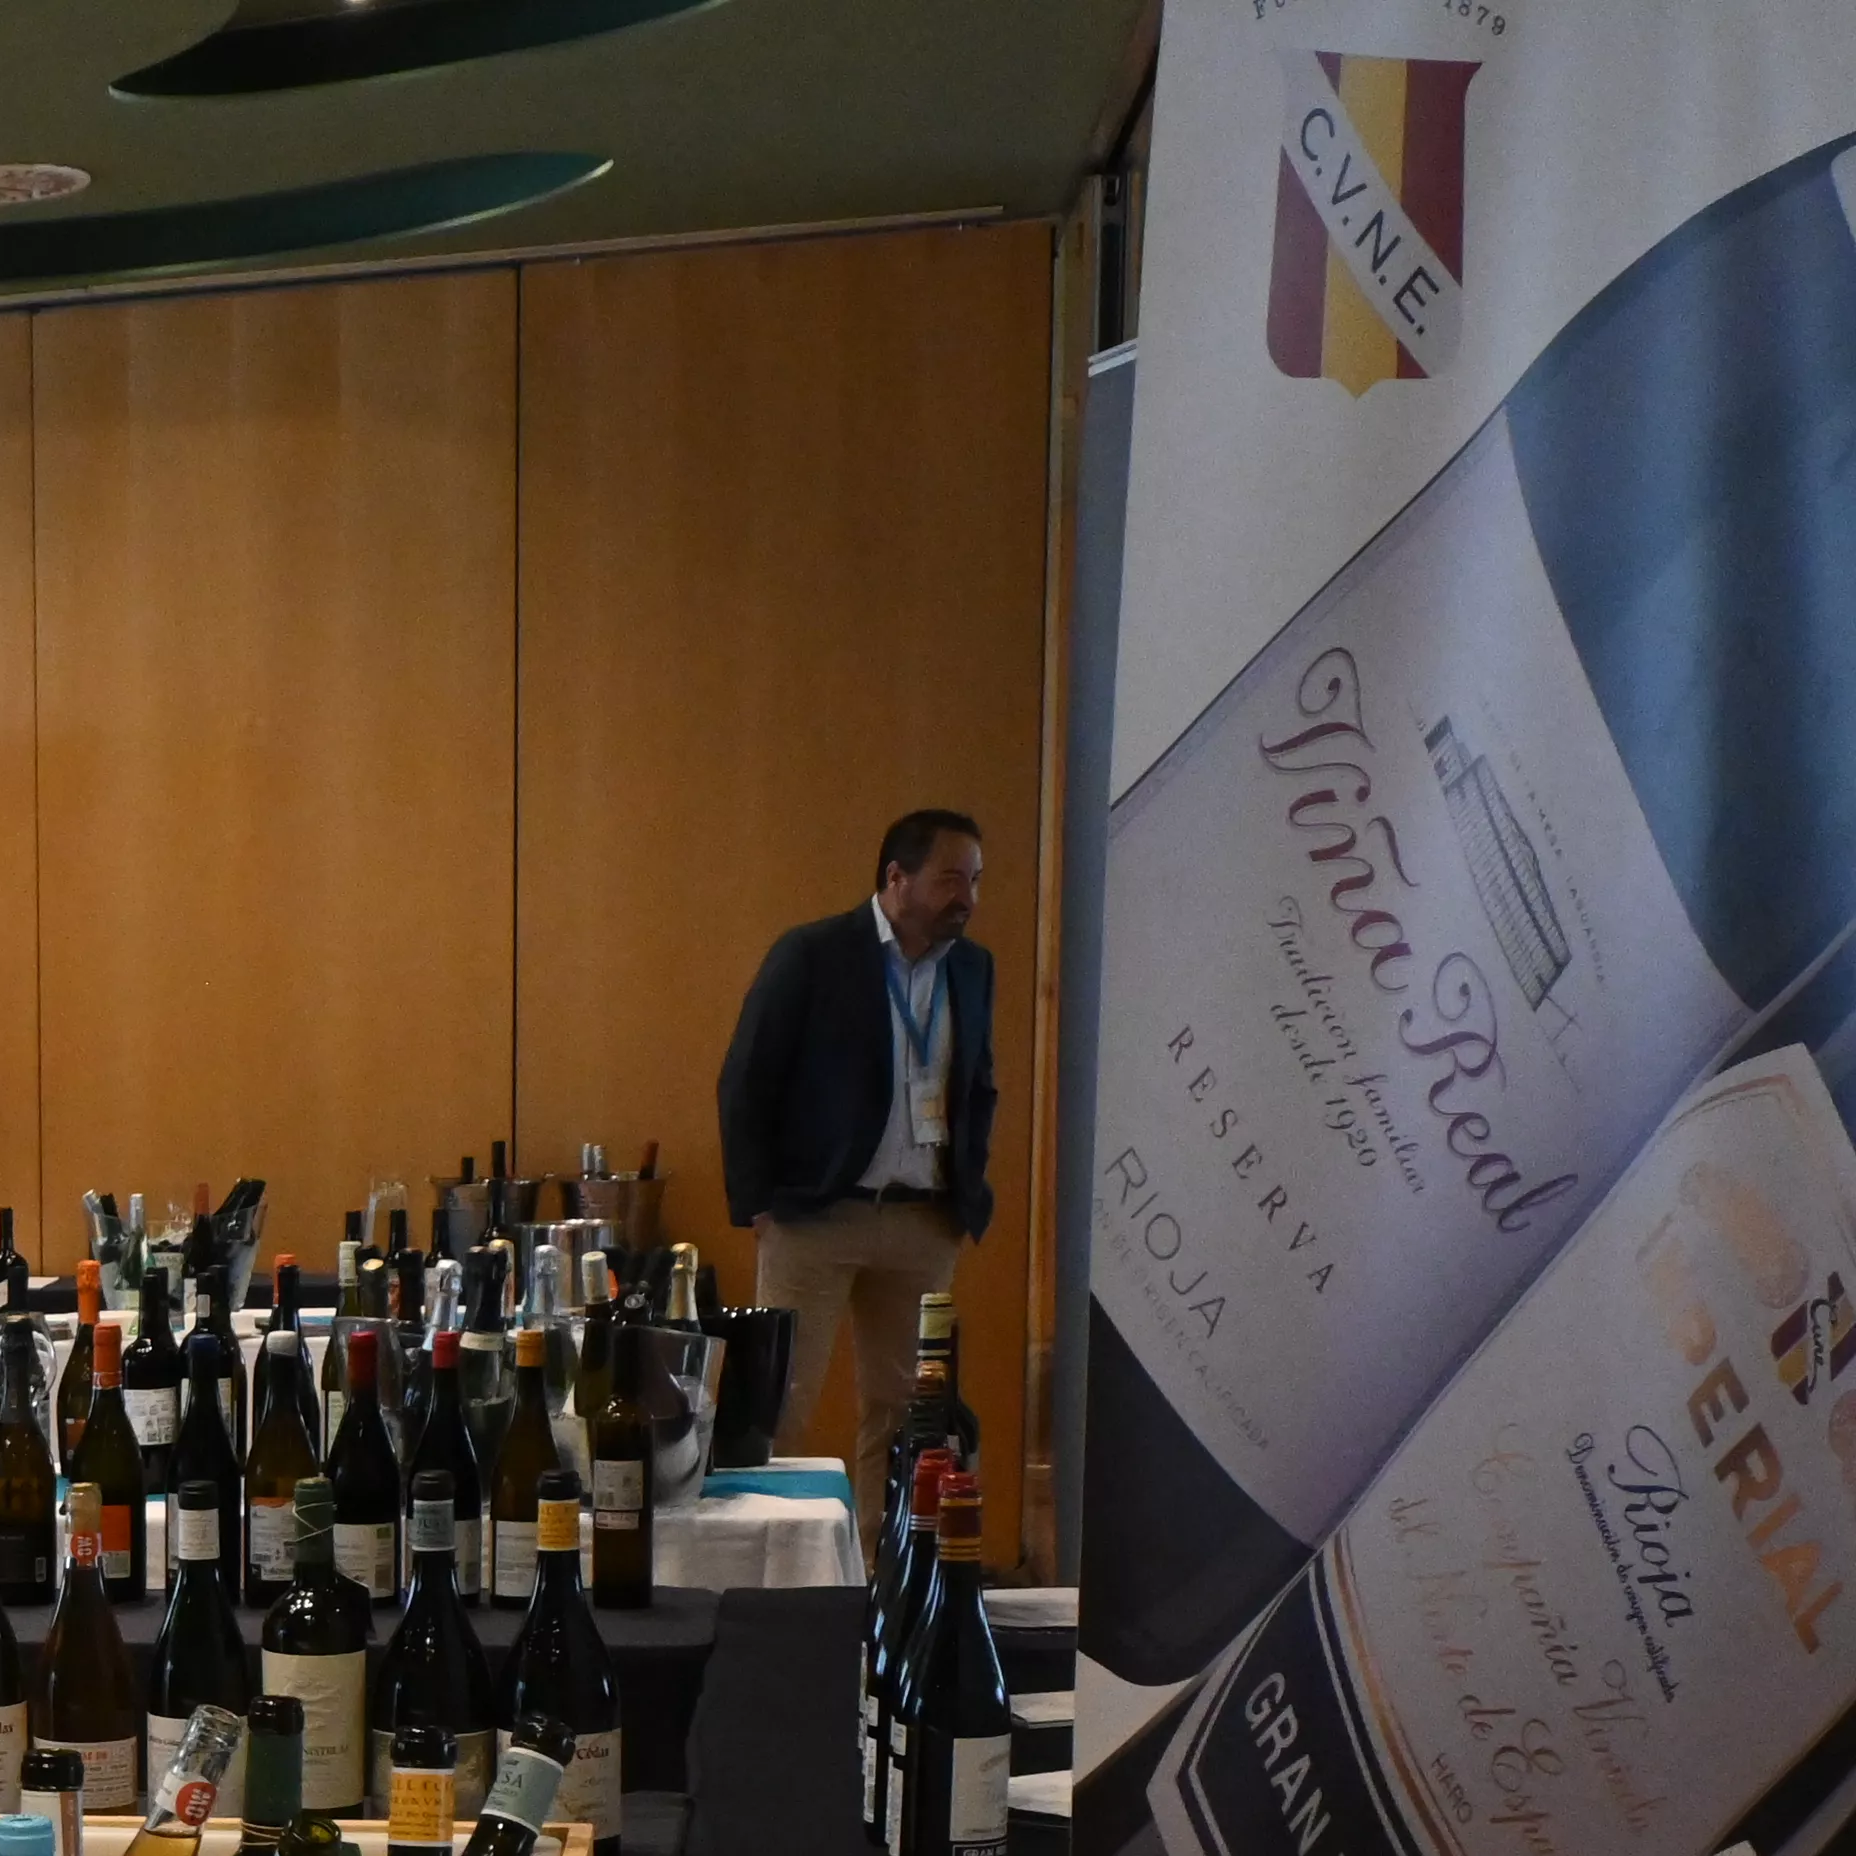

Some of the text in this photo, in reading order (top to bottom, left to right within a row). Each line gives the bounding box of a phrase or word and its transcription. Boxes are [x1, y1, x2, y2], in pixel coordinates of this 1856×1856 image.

[1442, 0, 1506, 37] 879
[1259, 646, 1580, 1236] Viña Real
[1166, 1022, 1338, 1294] RESERVA
[1270, 1003, 1377, 1167] desde 1920
[1103, 1146, 1226, 1340] RIOJA
[1607, 1424, 1695, 1628] Rioja
[1430, 1752, 1473, 1824] HARO
